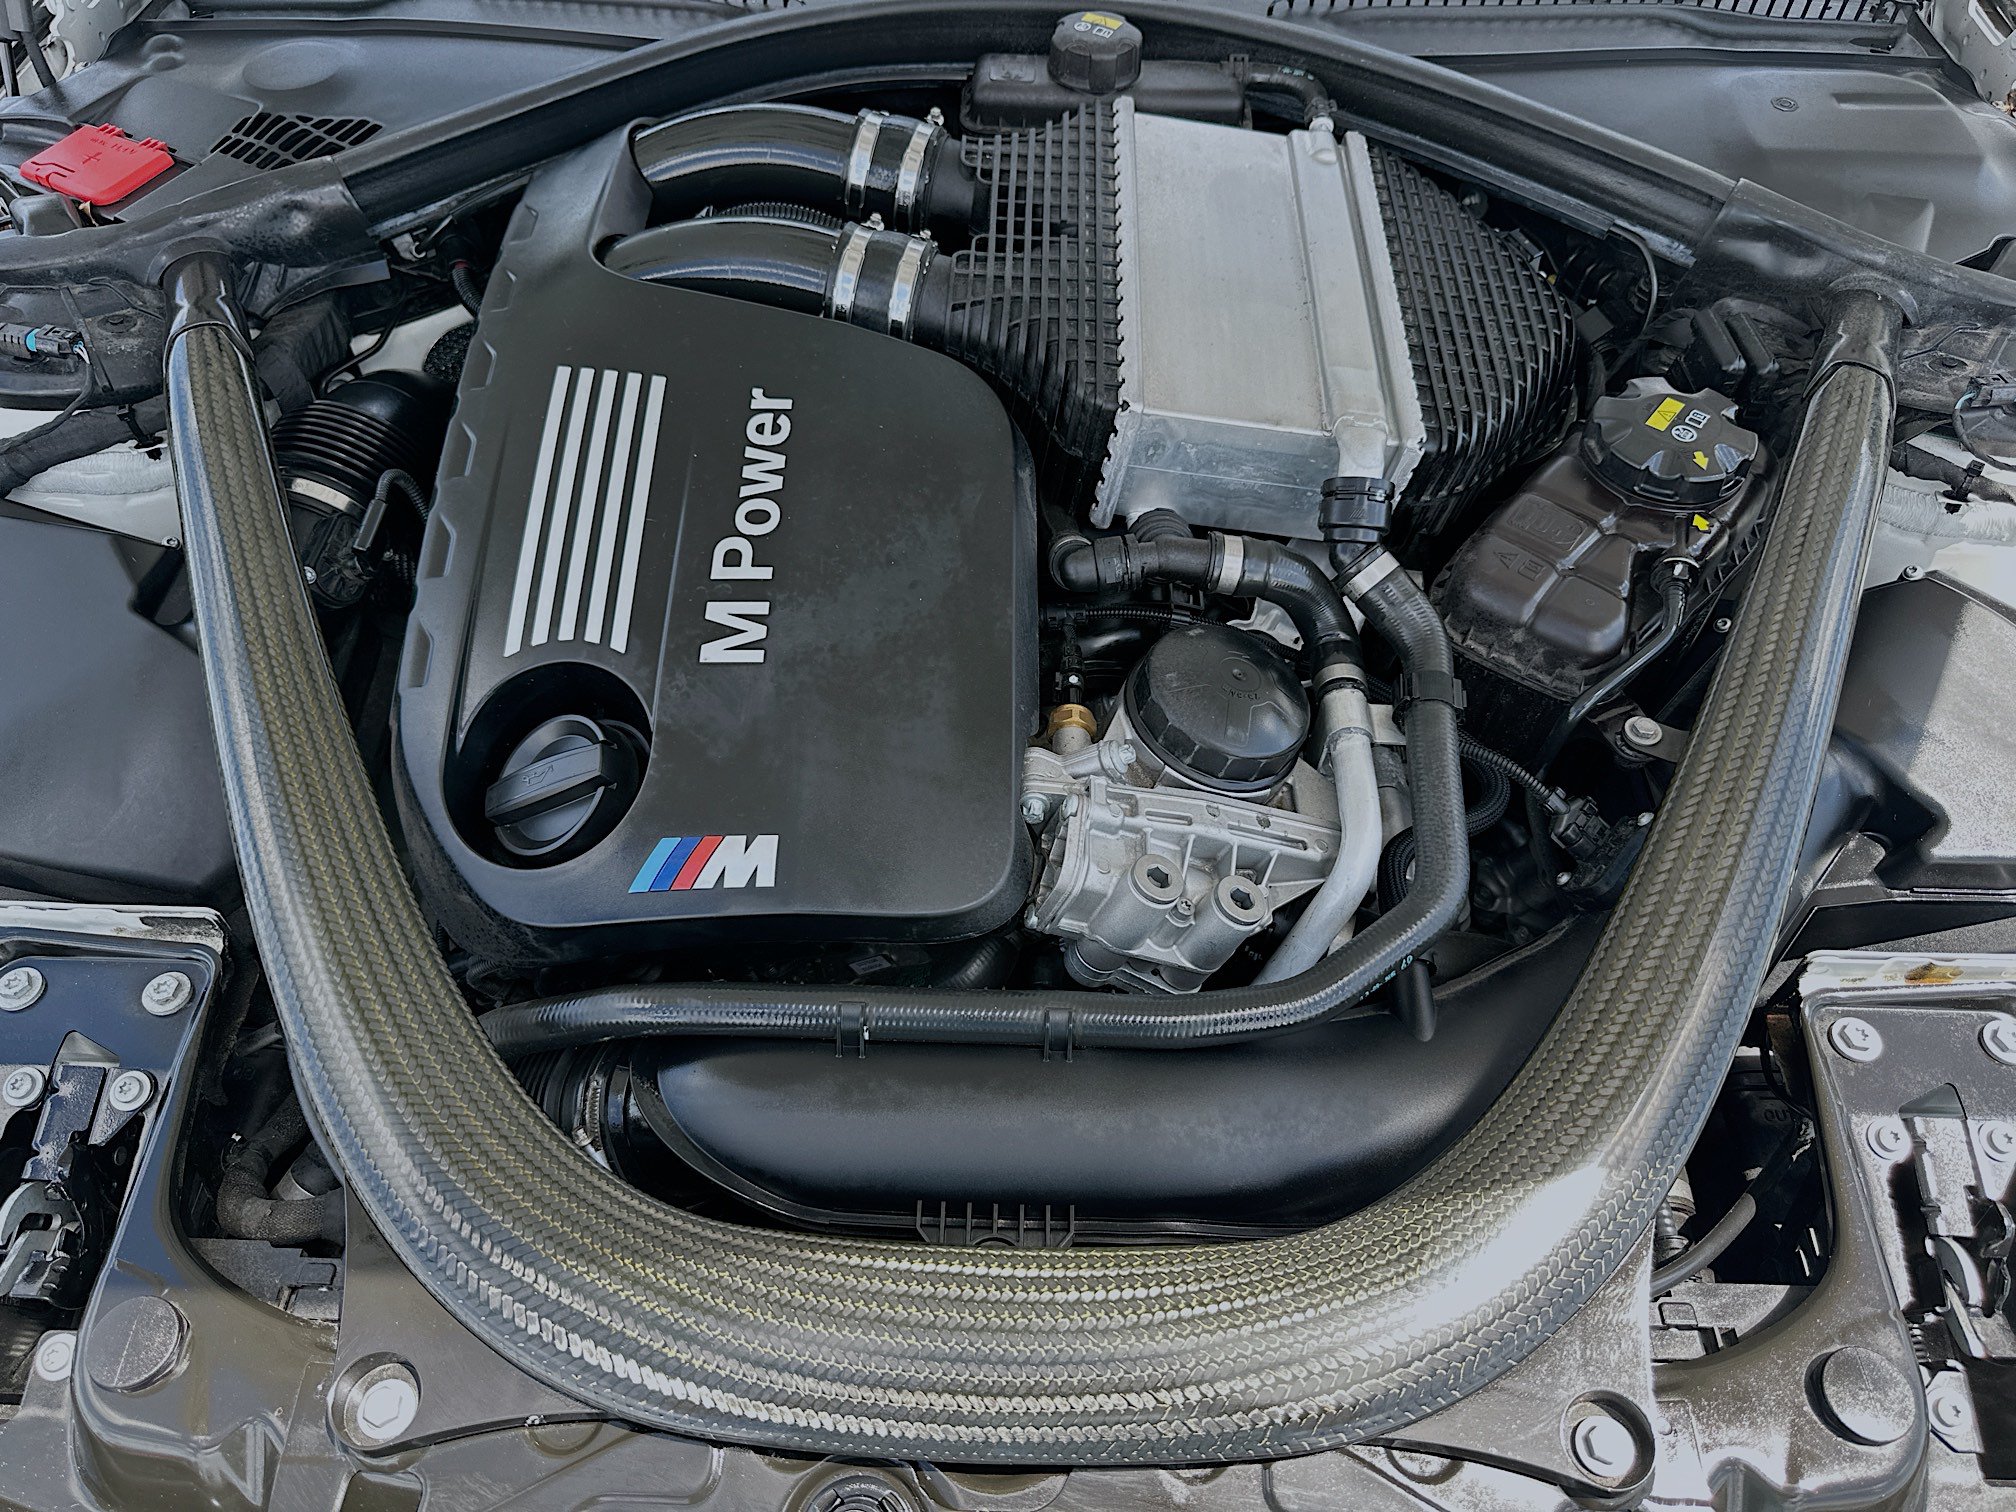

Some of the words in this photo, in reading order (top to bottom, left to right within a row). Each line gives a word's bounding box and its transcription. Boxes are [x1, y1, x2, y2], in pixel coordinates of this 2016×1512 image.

[710, 387, 793, 580] Power
[699, 601, 770, 663] M
[693, 834, 779, 889] M
